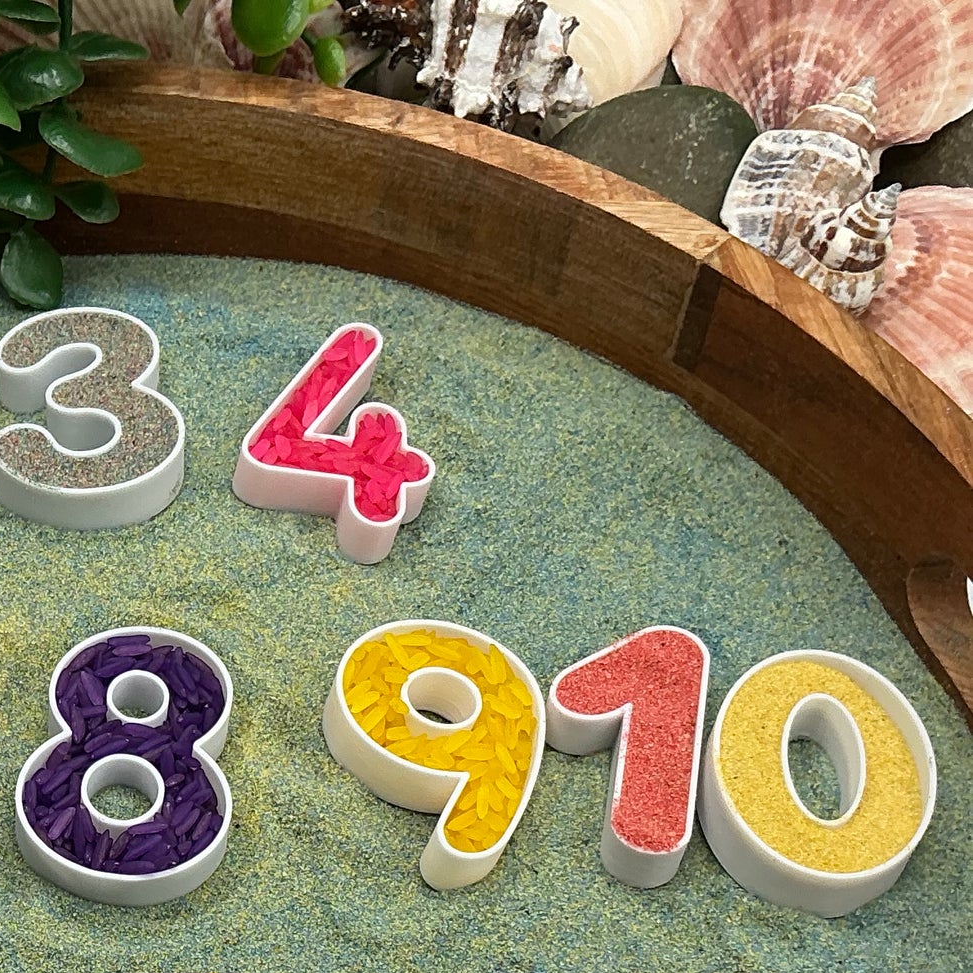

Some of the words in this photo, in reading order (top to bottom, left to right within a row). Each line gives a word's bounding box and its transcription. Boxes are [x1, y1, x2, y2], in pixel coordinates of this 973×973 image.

[235, 322, 436, 562] 4
[17, 627, 232, 905] 8
[323, 619, 546, 889] 9
